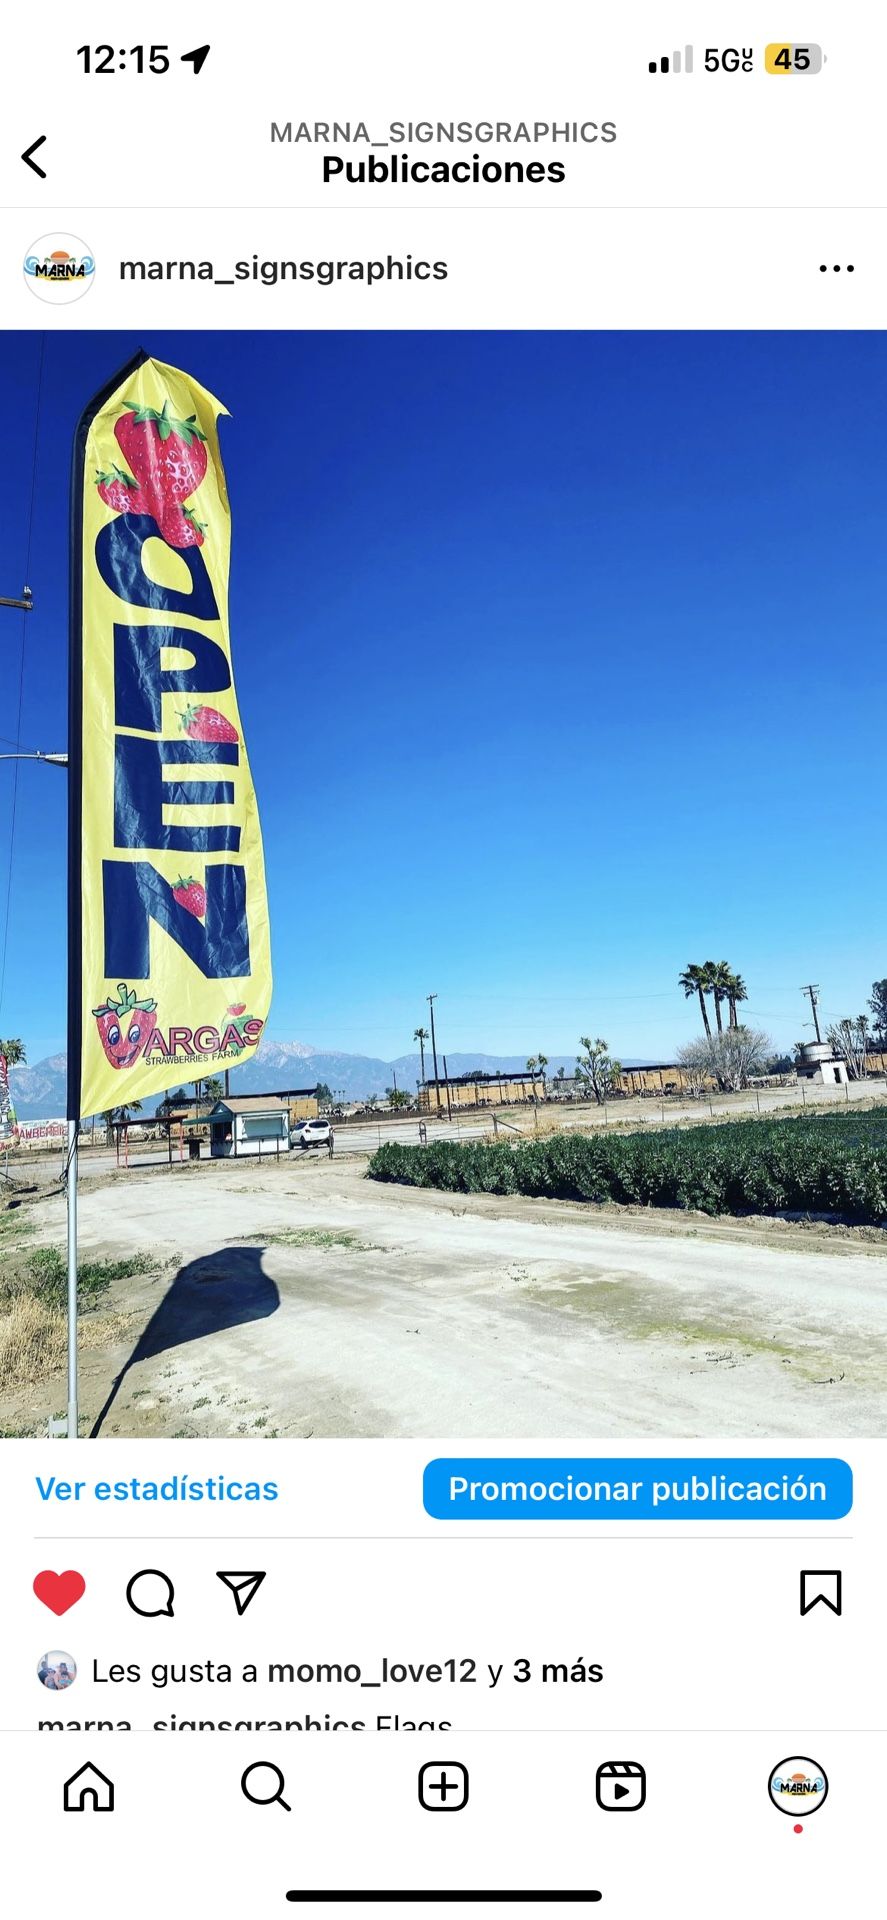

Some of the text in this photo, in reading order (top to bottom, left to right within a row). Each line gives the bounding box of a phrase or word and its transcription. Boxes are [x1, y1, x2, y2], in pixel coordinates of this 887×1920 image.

[95, 512, 252, 980] OPEN
[145, 1049, 240, 1066] STRAWBERRIES FARM
